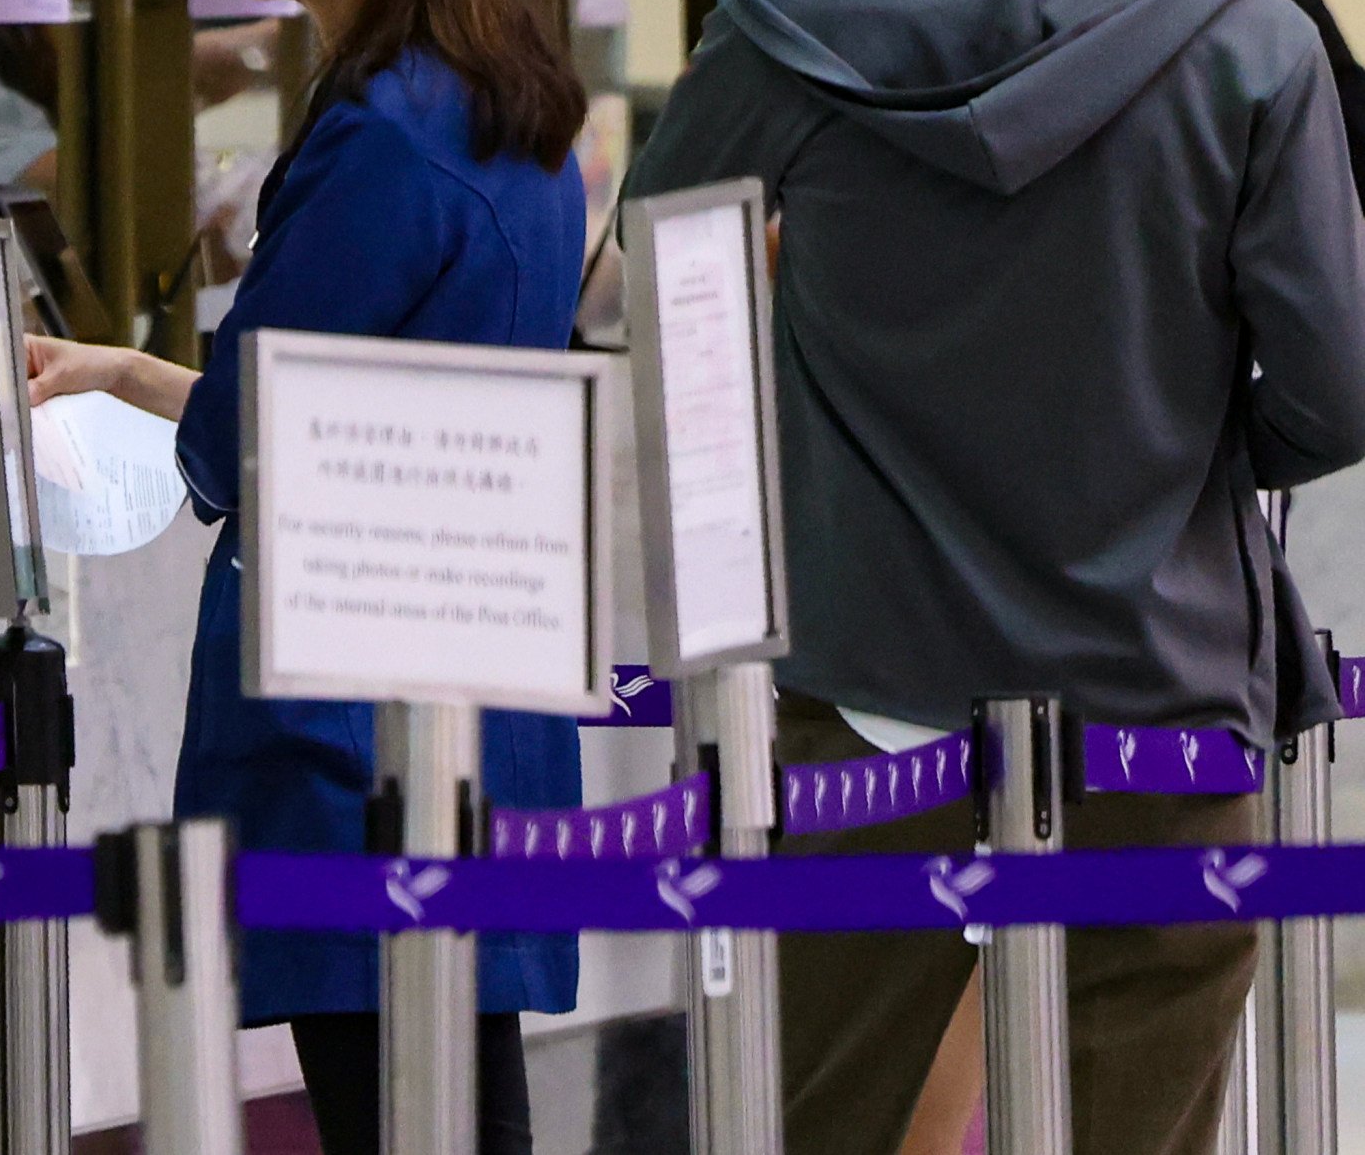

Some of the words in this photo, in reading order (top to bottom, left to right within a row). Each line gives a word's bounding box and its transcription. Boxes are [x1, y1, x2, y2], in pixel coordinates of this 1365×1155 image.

[278, 514, 303, 532] For
[308, 521, 362, 542] security
[431, 528, 477, 549] please
[534, 534, 569, 555] from
[427, 568, 463, 585] make
[468, 572, 545, 594] recordings
[306, 592, 327, 612] the
[451, 603, 475, 624] the
[477, 606, 509, 627] Post
